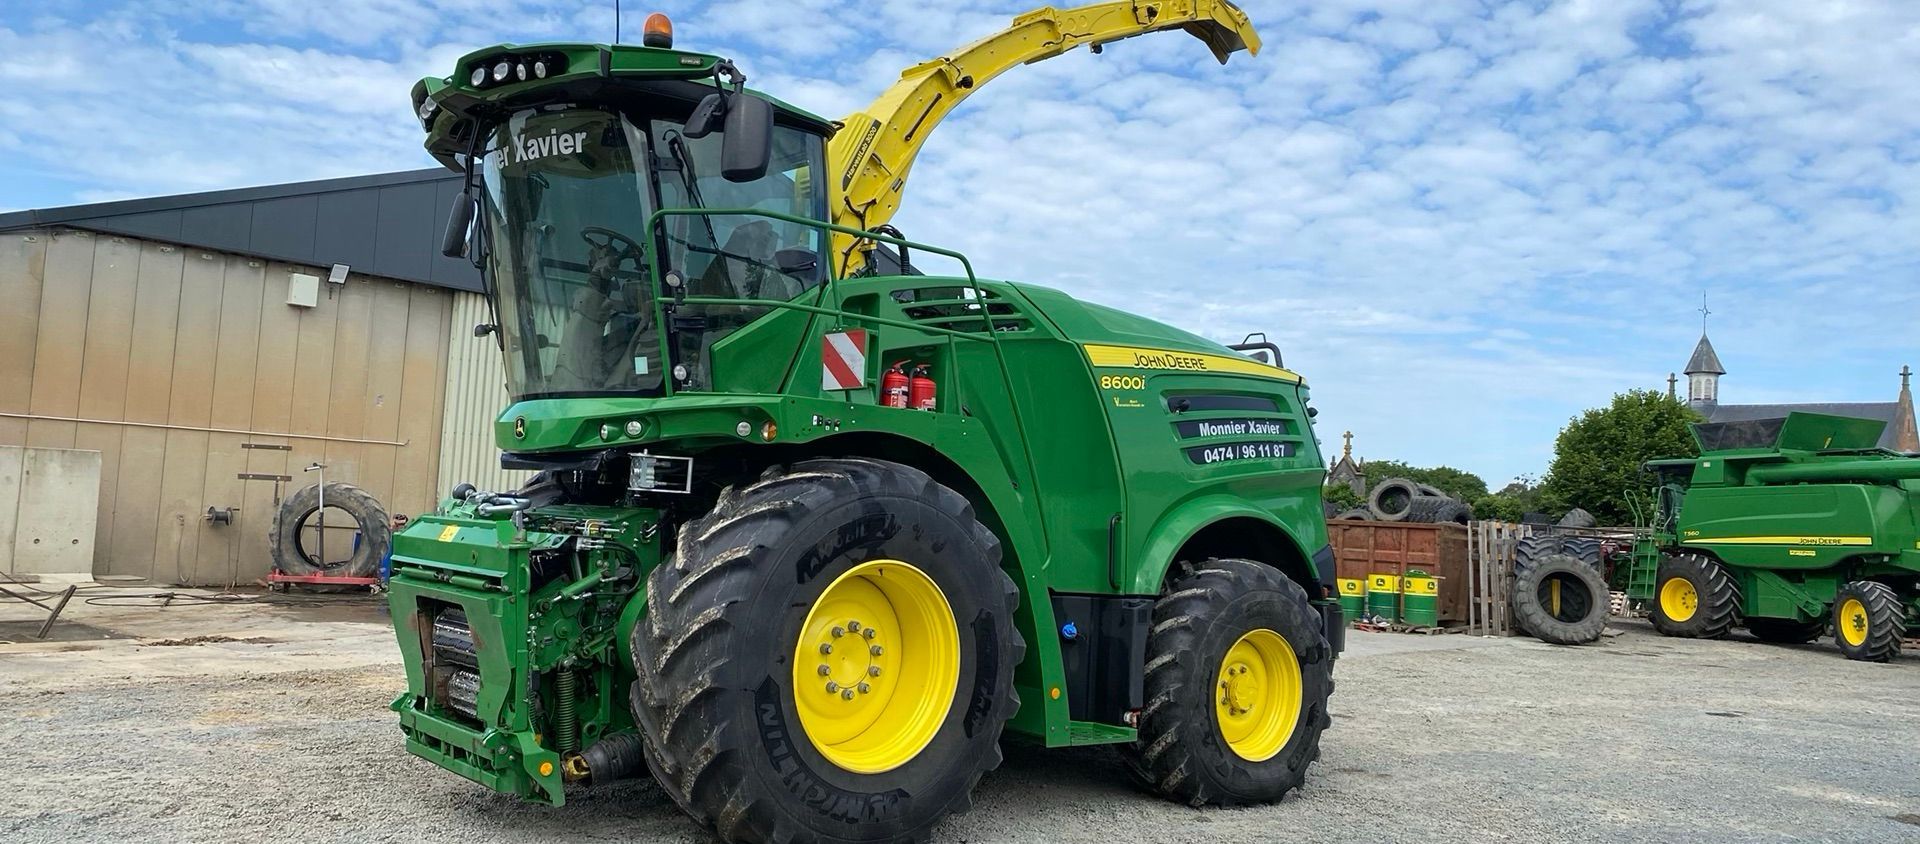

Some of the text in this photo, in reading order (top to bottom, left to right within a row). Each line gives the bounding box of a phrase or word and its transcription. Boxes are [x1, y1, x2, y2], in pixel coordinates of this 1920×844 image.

[513, 128, 587, 163] Xavier
[846, 126, 877, 179] HarvestLab 3000
[1133, 352, 1207, 370] JOHN DEERE
[1101, 374, 1146, 390] 8600i
[1199, 420, 1280, 437] Monnier Xavier
[1204, 446, 1234, 463] 0474
[1242, 444, 1256, 459] 96
[1258, 444, 1271, 458] 11
[1273, 444, 1285, 458] 87
